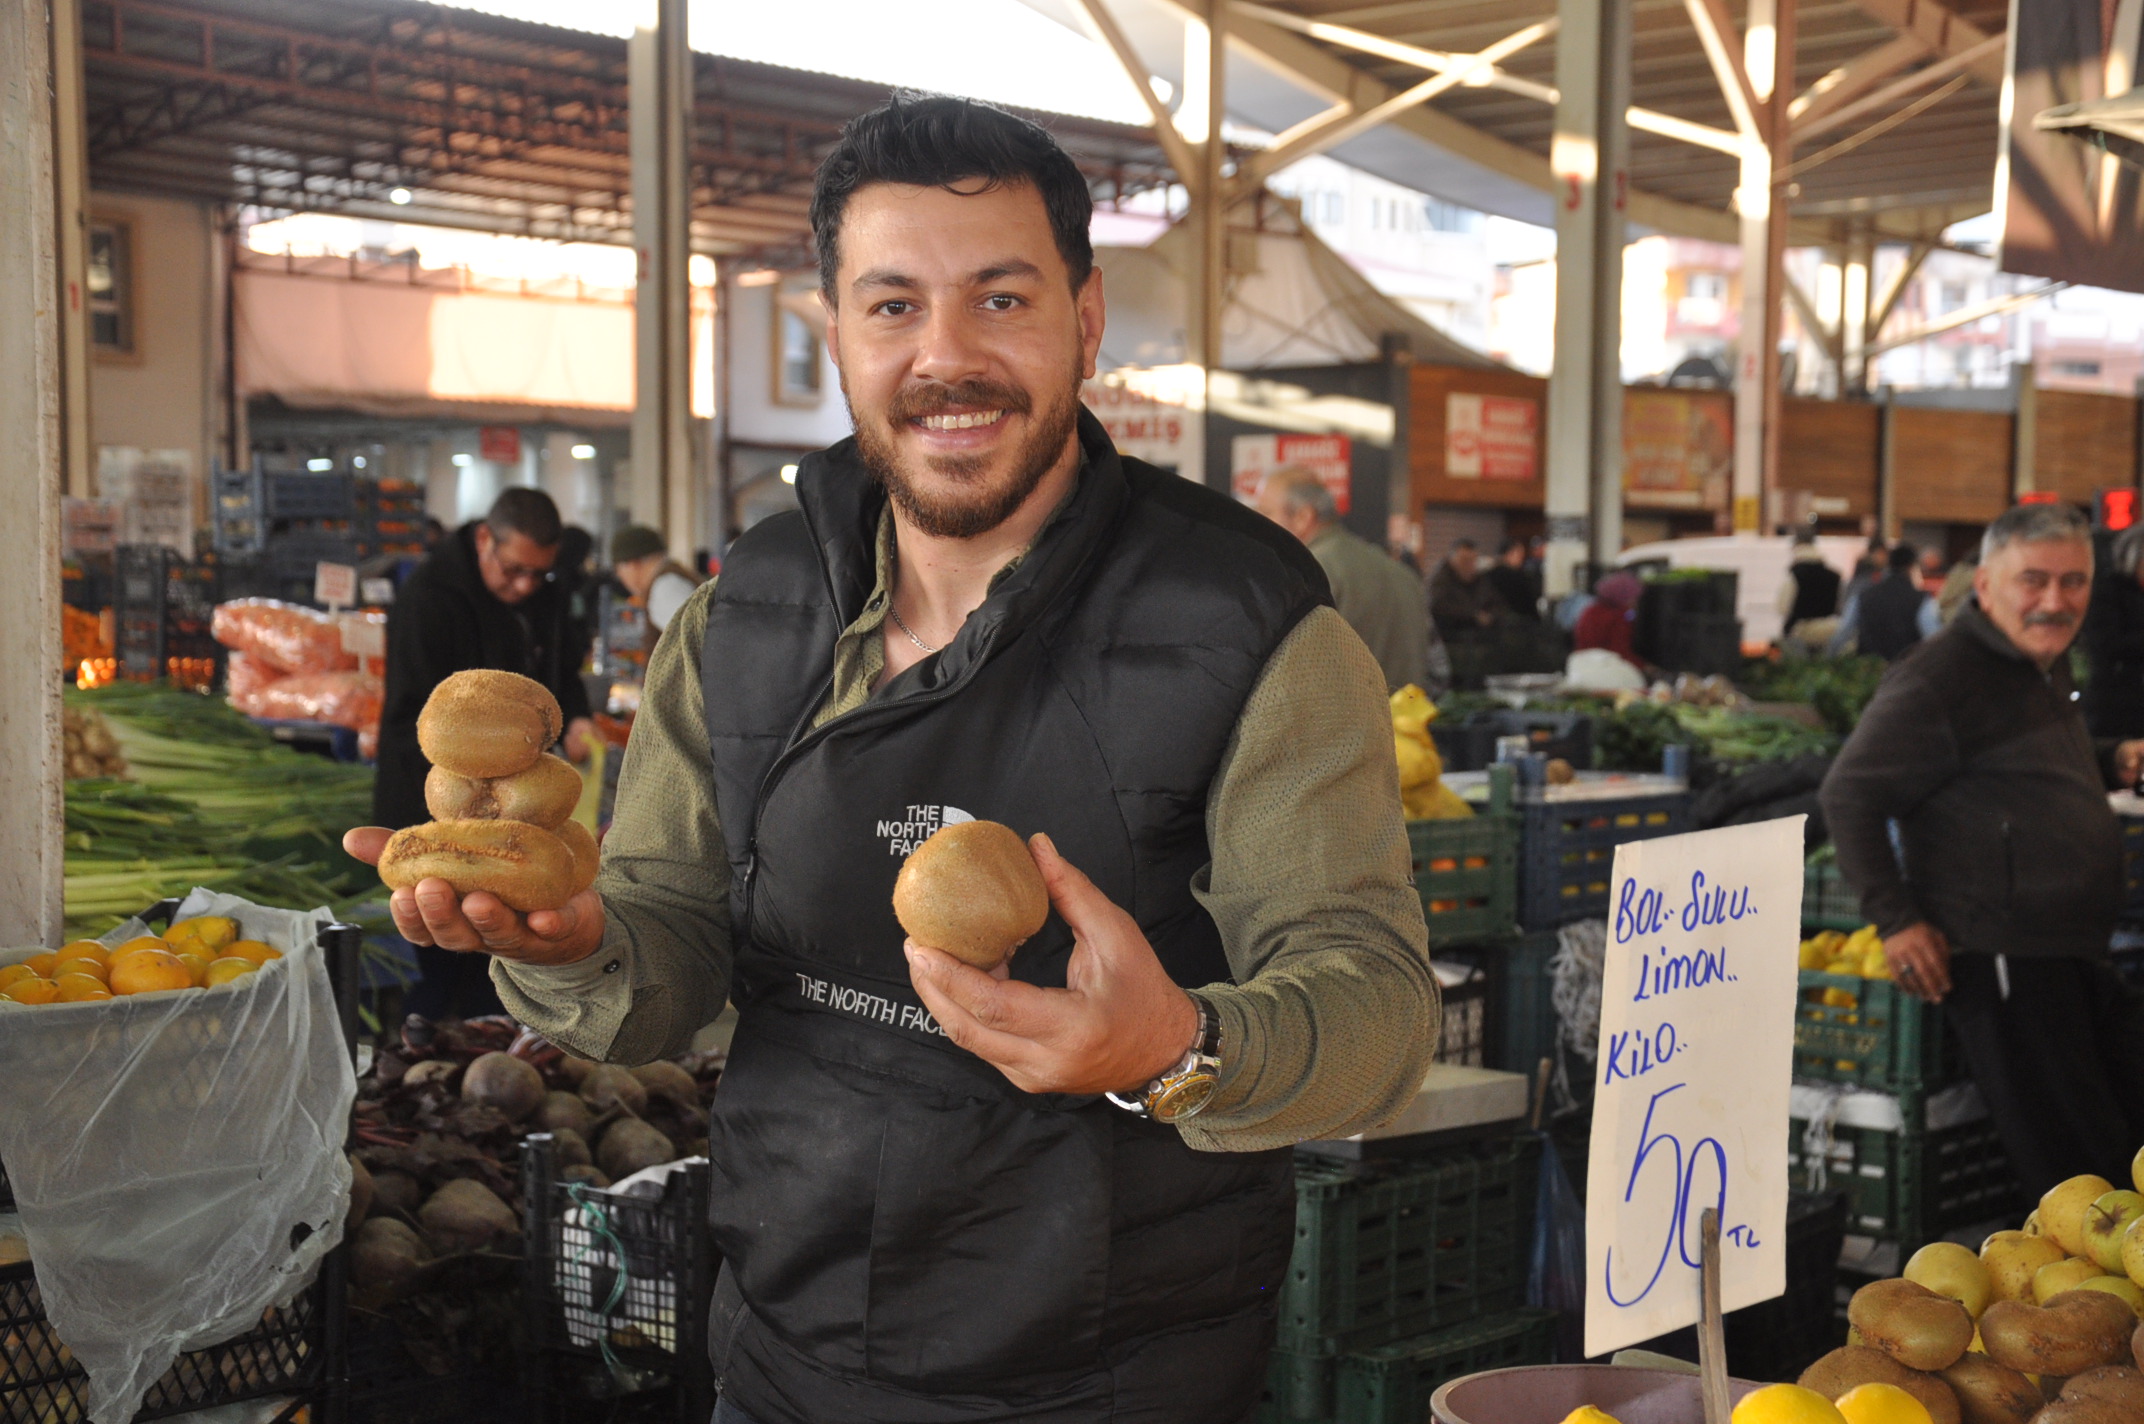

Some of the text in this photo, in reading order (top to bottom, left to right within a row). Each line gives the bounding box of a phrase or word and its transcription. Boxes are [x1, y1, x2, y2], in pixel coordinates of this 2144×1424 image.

[906, 804, 940, 822] THE
[876, 819, 938, 839] NORTH
[889, 838, 925, 856] FAC
[796, 973, 948, 1037] THE NORTH FAC
[1606, 1083, 1761, 1307] 50 TL
